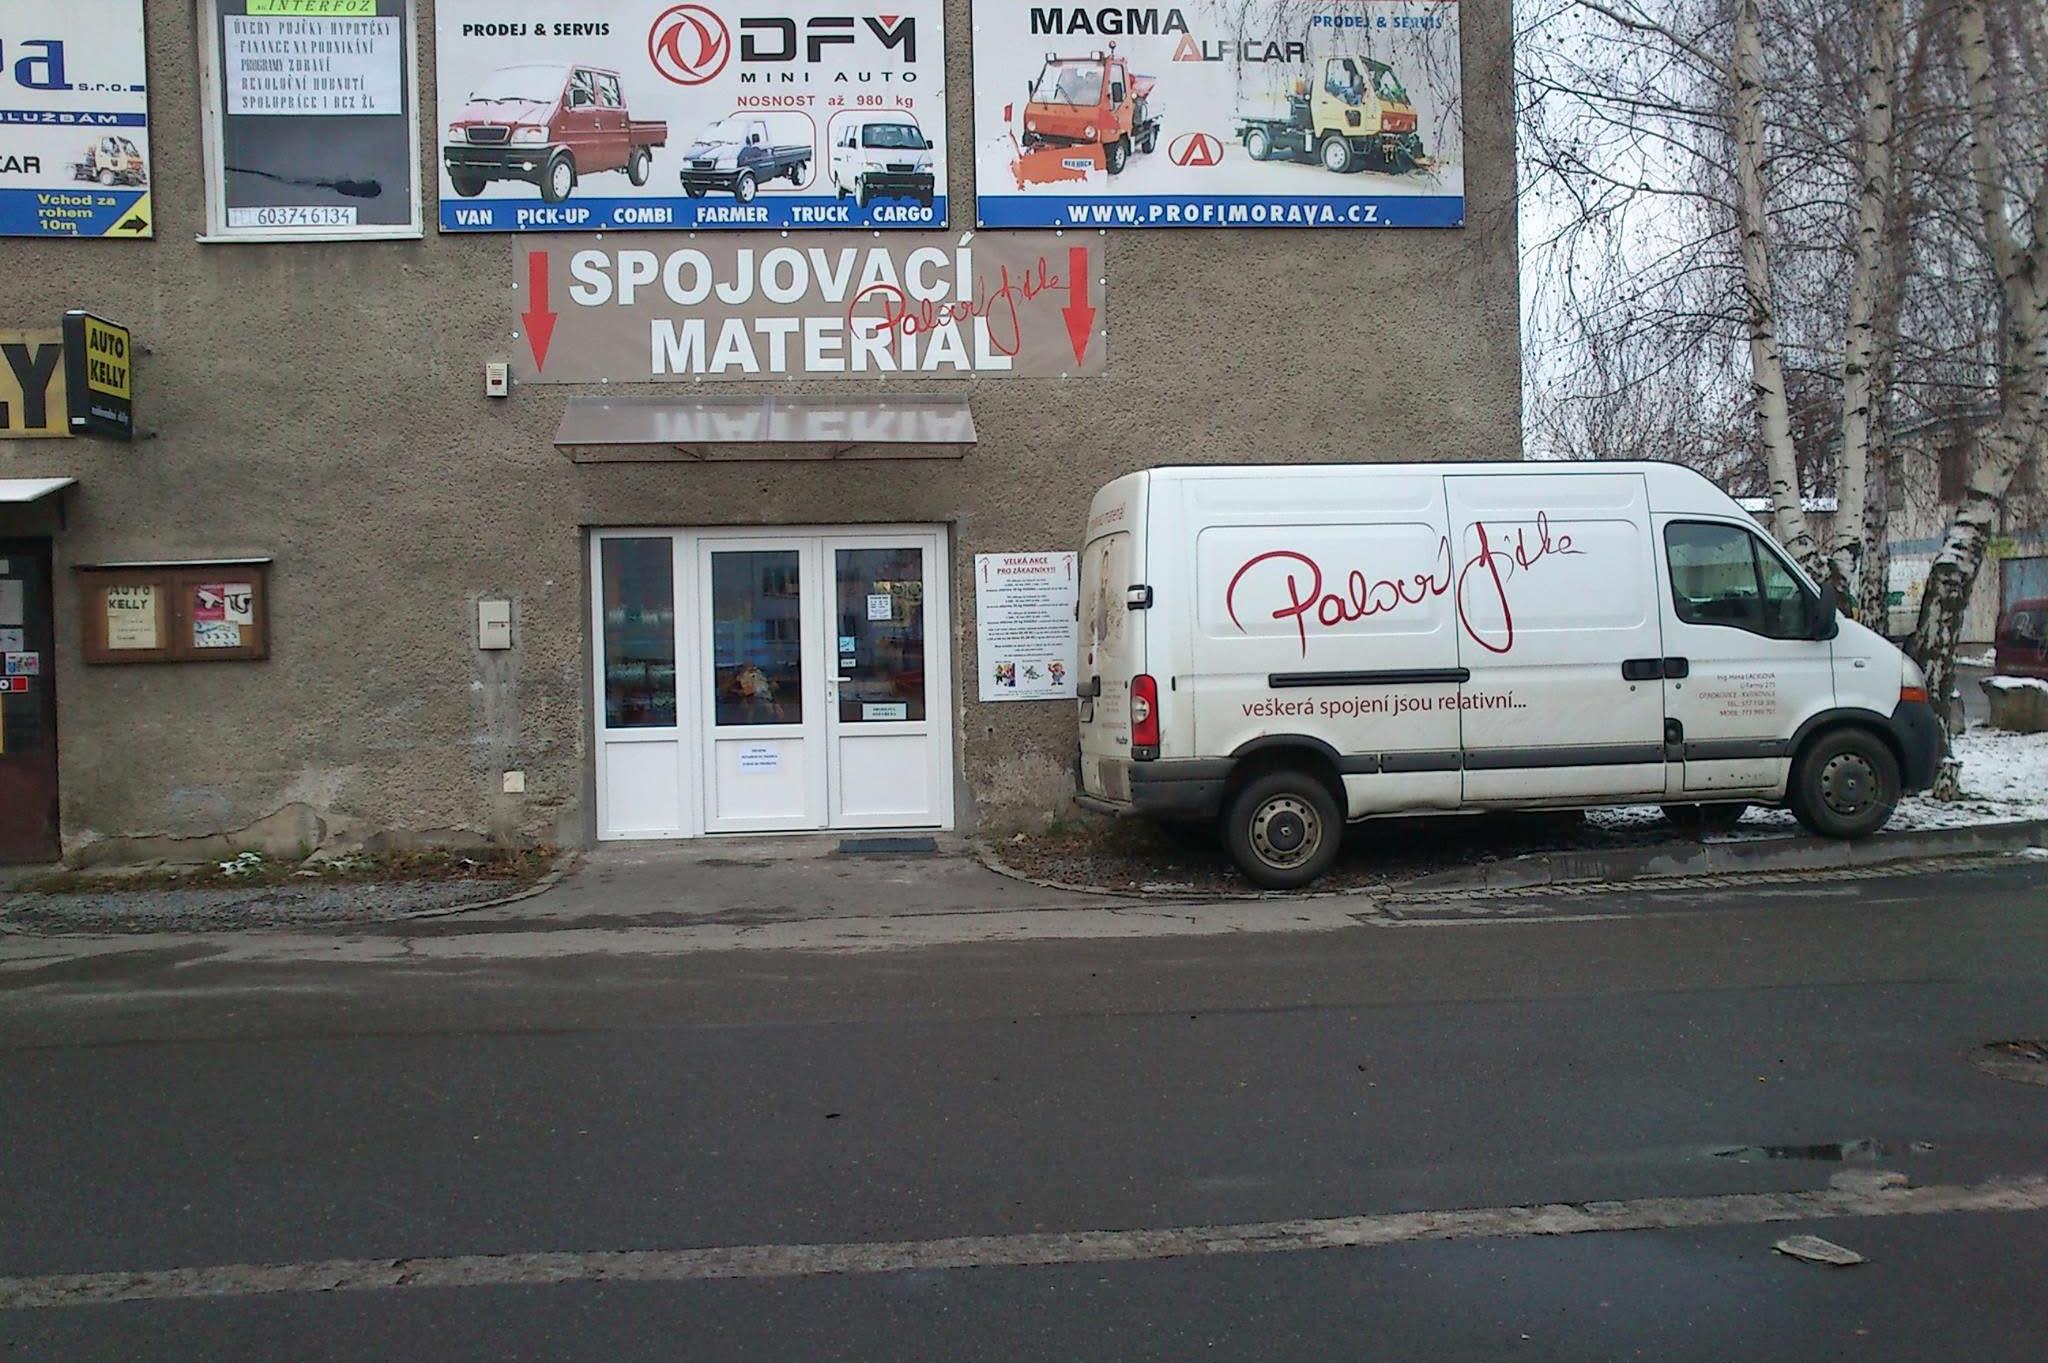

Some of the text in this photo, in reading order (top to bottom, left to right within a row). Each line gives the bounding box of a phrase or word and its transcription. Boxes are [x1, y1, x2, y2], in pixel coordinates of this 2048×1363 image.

[1030, 8, 1190, 36] MAGMA
[1312, 15, 1443, 29] PRODEJ & SERVIS
[462, 23, 611, 37] PRODEJ & SERVIS
[239, 40, 290, 54] FINANCE
[739, 16, 917, 64] DFM
[741, 72, 918, 84] MINI AUTO
[78, 83, 128, 92] s.r.o.
[736, 95, 915, 110] NOSNOST až 980 kg
[0, 155, 41, 174] AR
[38, 194, 116, 206] Vchod za
[38, 207, 93, 218] rohem
[455, 207, 934, 225] VAN PICK-UP COMBI FARMER TRUCK CARGO
[40, 220, 77, 231] 10m
[568, 231, 974, 306] SPOJOVACÍ
[90, 327, 125, 359] AUTO
[650, 303, 1014, 375] MATERIÁL
[90, 358, 126, 389] KELLY
[1003, 557, 1028, 565] VELKÁ
[996, 567, 1011, 575] PRO
[108, 598, 148, 610] KELLY
[1241, 690, 1527, 718] veškerá spojení jsou relativní...
